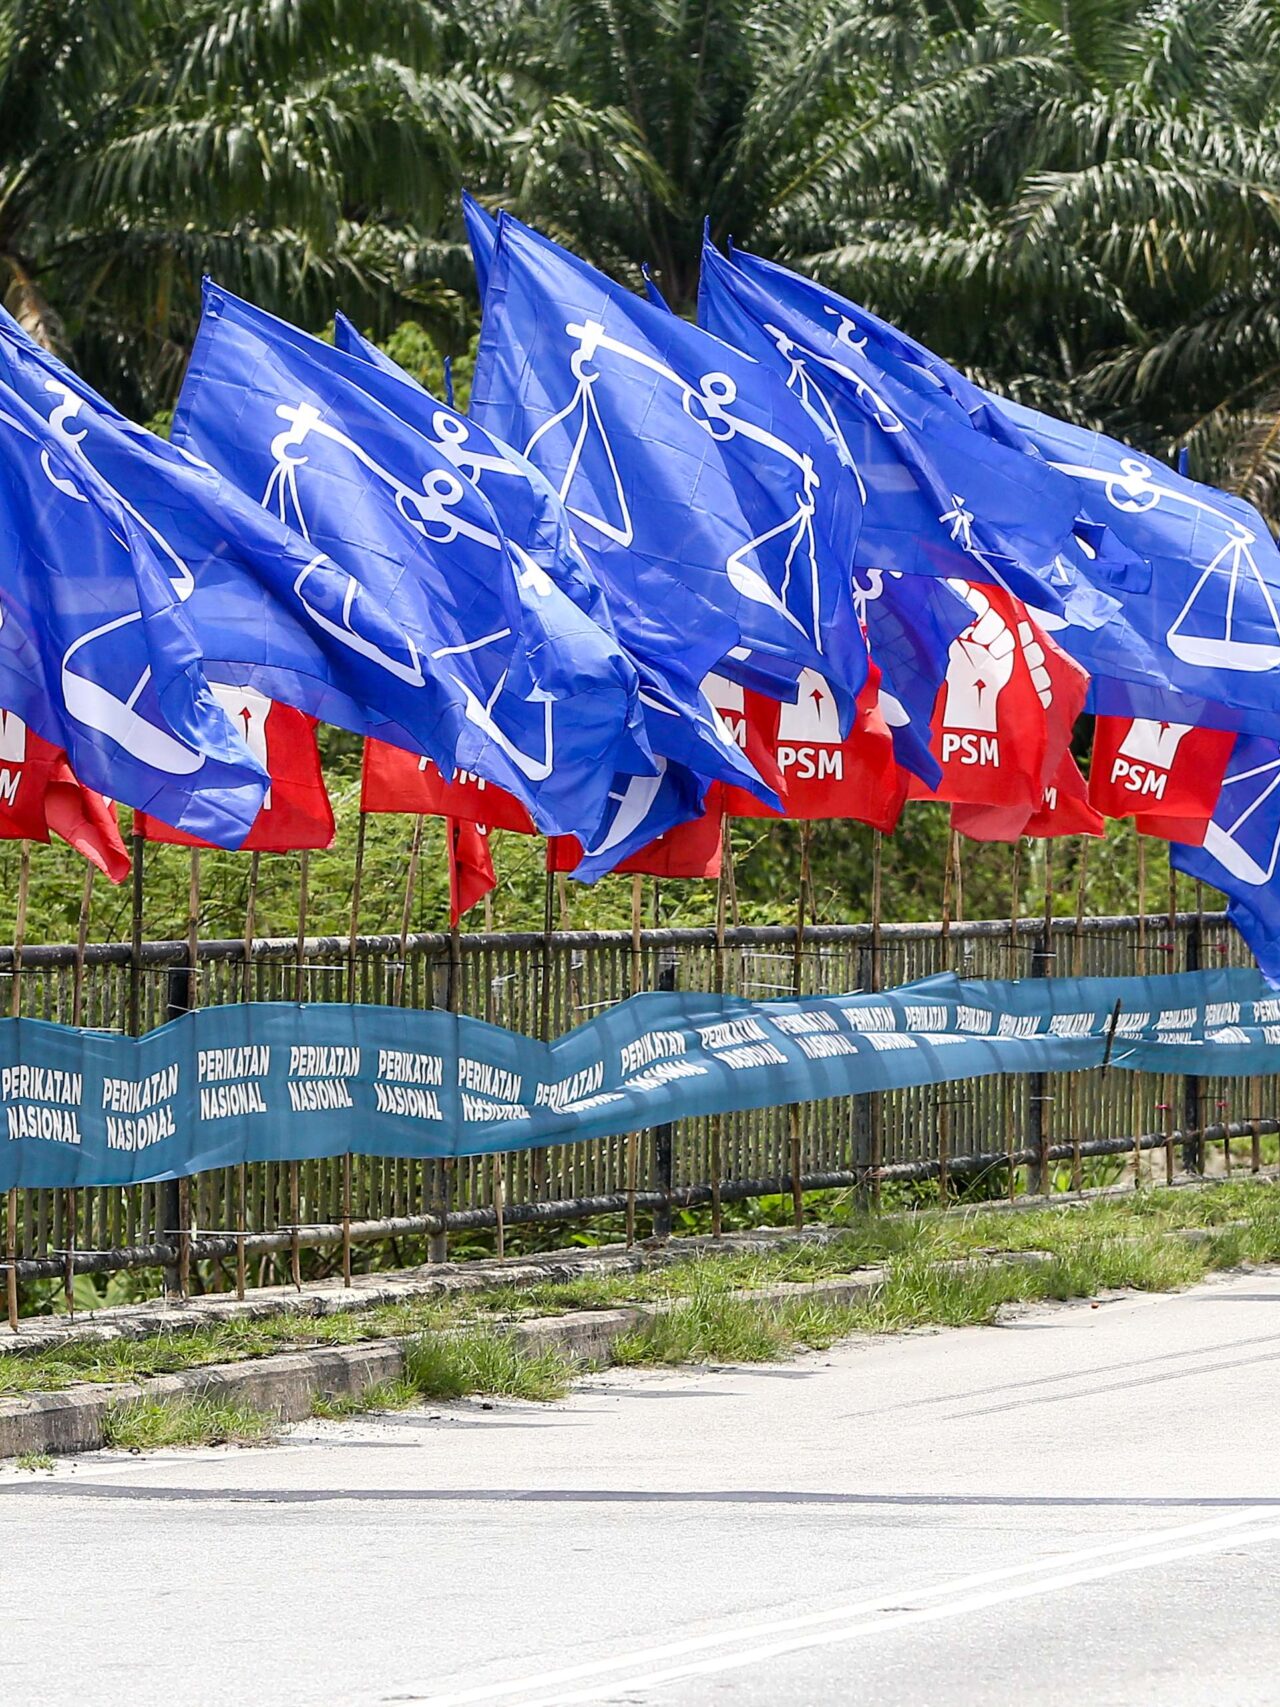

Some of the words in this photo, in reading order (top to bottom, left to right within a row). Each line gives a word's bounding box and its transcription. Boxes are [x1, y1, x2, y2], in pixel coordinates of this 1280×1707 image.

[777, 746, 843, 780] PSM
[942, 733, 999, 767] PSM
[1110, 758, 1168, 800] PSM
[620, 1030, 687, 1077] PERIKATAN
[695, 1018, 770, 1050] PERIKATAN
[794, 1034, 859, 1060] NASIONAL
[198, 1045, 270, 1082] PERIKATAN
[288, 1046, 360, 1077] PERIKATAN
[377, 1049, 443, 1086] PERIKATAN
[712, 1043, 789, 1070] NASIONAL
[2, 1064, 83, 1106] PERIKATAN
[102, 1063, 179, 1114] PERIKATAN
[287, 1077, 354, 1112] NASIONAL
[458, 1057, 522, 1103] PERIKATAN
[534, 1060, 604, 1110] PERIKATAN
[200, 1081, 268, 1121] NASIONAL
[374, 1082, 443, 1121] NASIONAL
[7, 1105, 82, 1145] NASIONAL
[106, 1104, 177, 1152] NASIONAL
